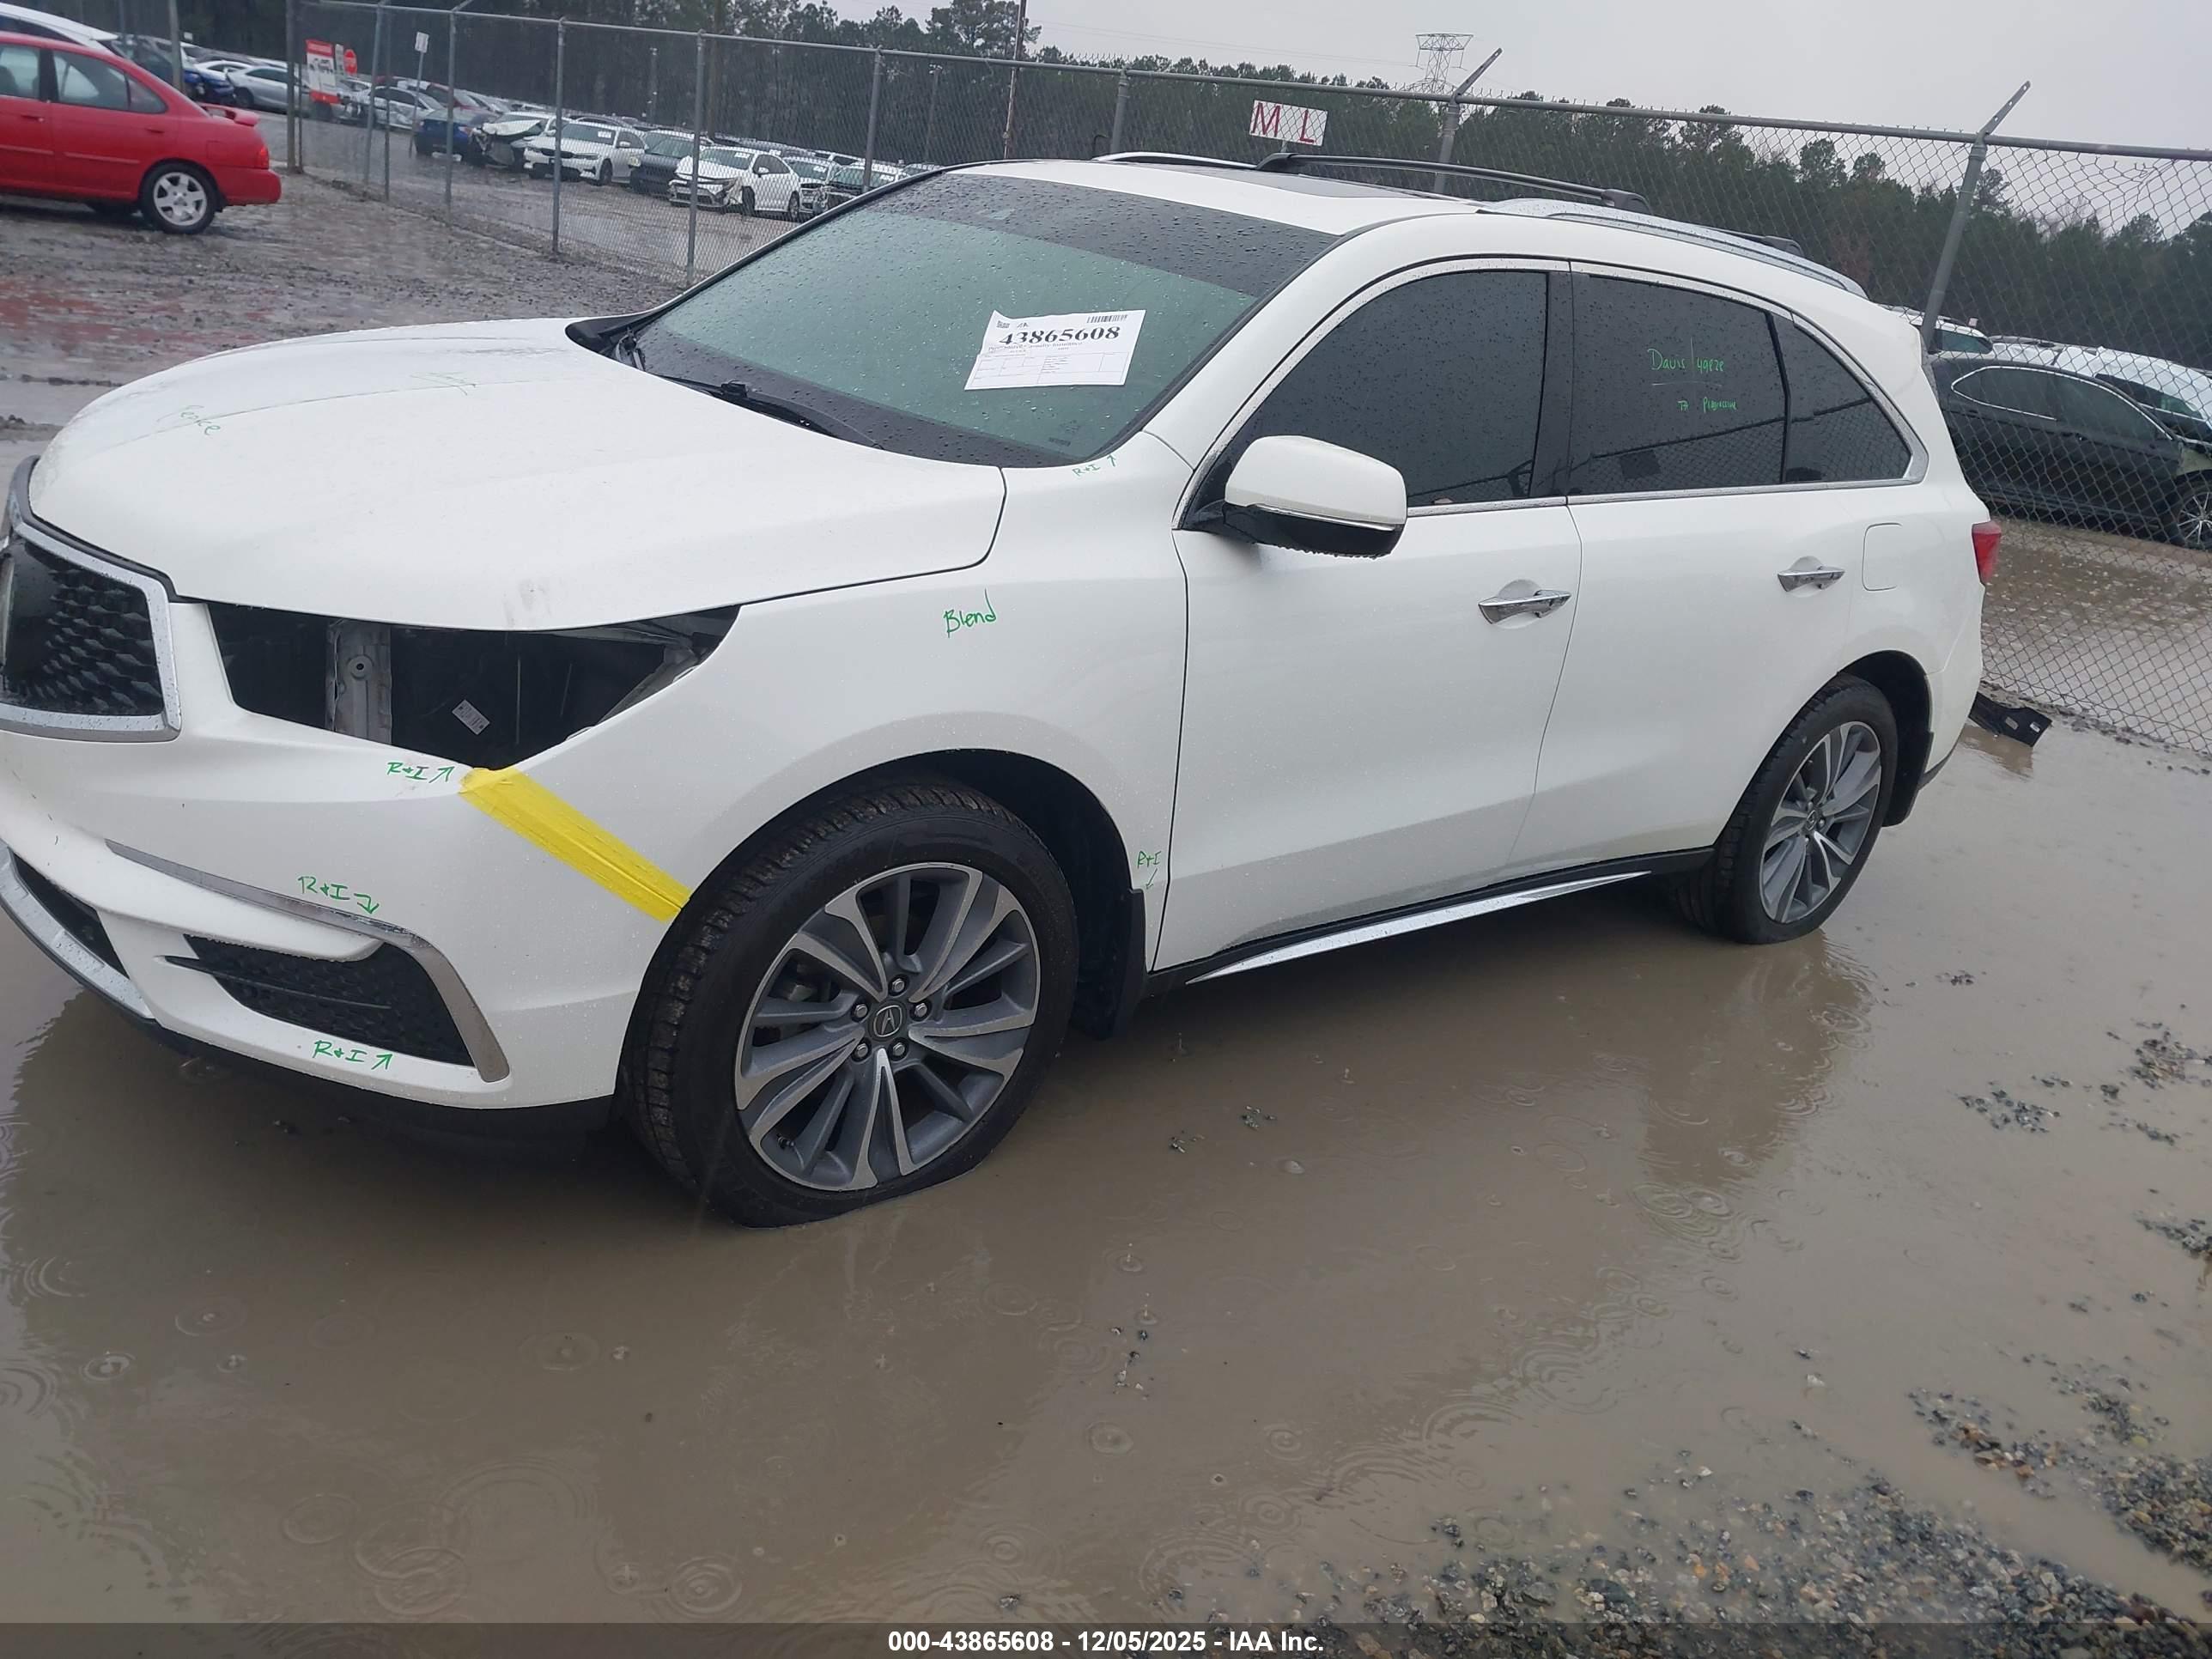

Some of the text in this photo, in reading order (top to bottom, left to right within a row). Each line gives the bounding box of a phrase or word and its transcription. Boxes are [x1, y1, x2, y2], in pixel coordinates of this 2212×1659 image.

[1252, 102, 1315, 143] M L
[999, 325, 1121, 345] 43865608
[943, 587, 997, 638] Blend
